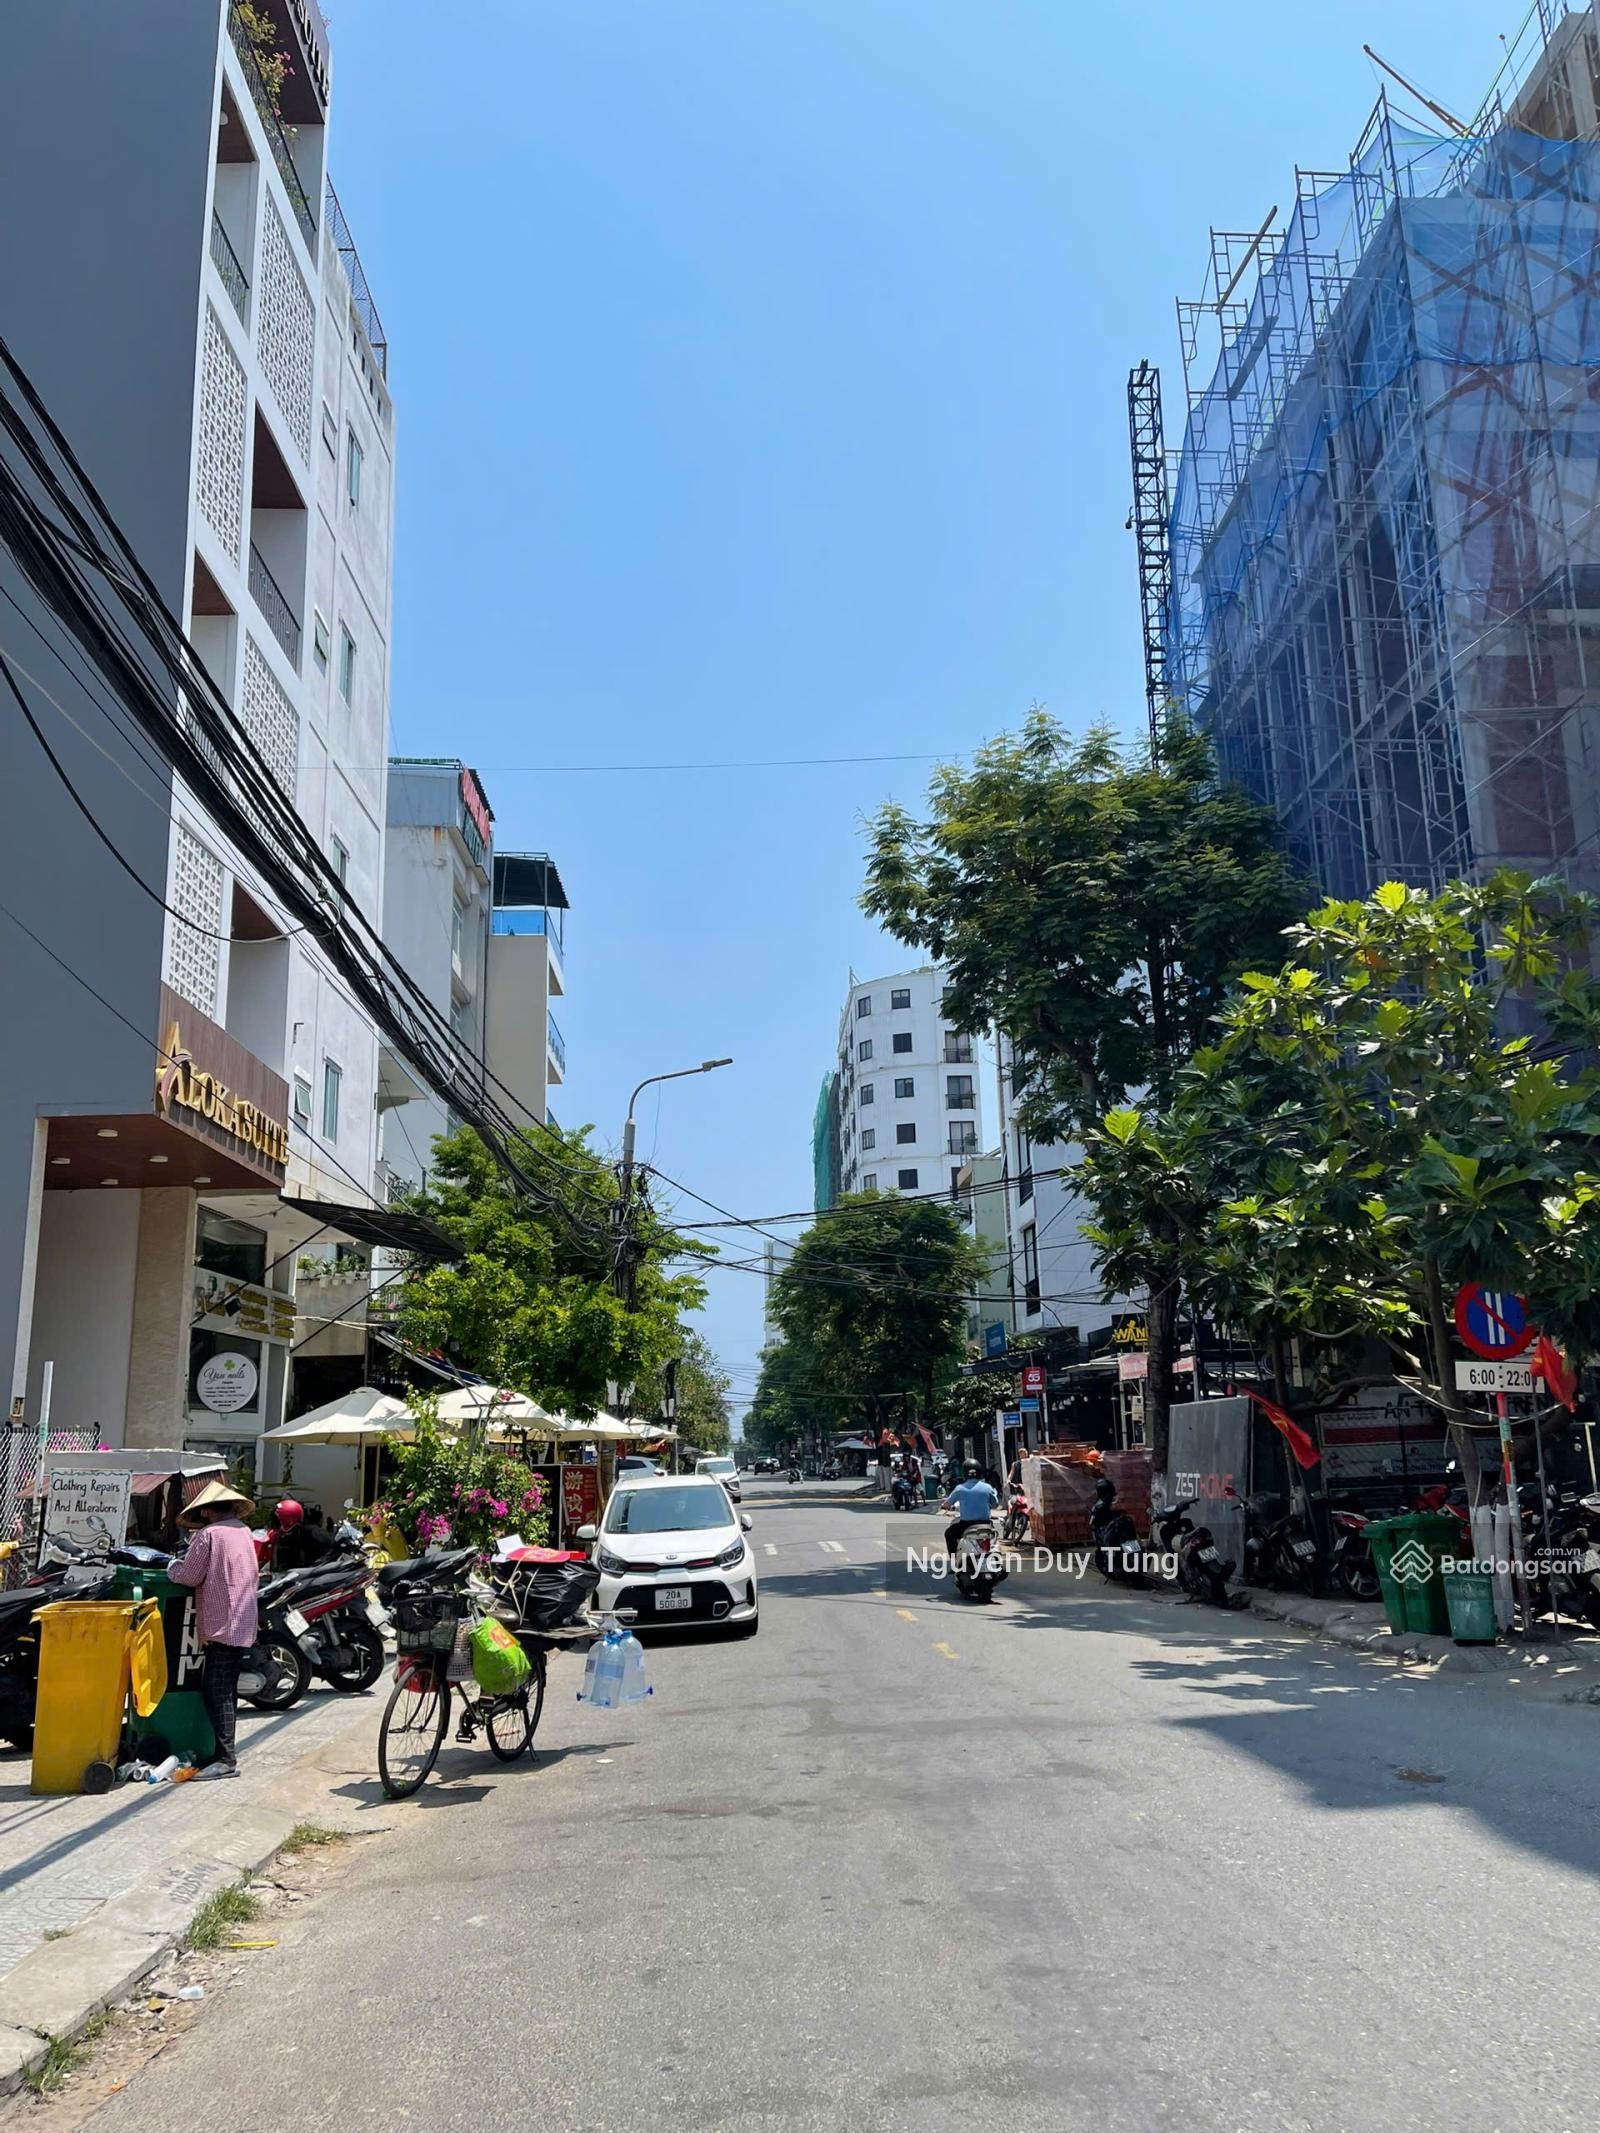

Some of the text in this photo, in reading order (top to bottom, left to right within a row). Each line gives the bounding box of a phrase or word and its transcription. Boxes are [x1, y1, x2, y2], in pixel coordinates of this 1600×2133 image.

[1469, 1369, 1496, 1385] 6:00
[52, 1478, 120, 1497] Clothing Repairs
[54, 1500, 71, 1512] And
[665, 1591, 681, 1599] 20A
